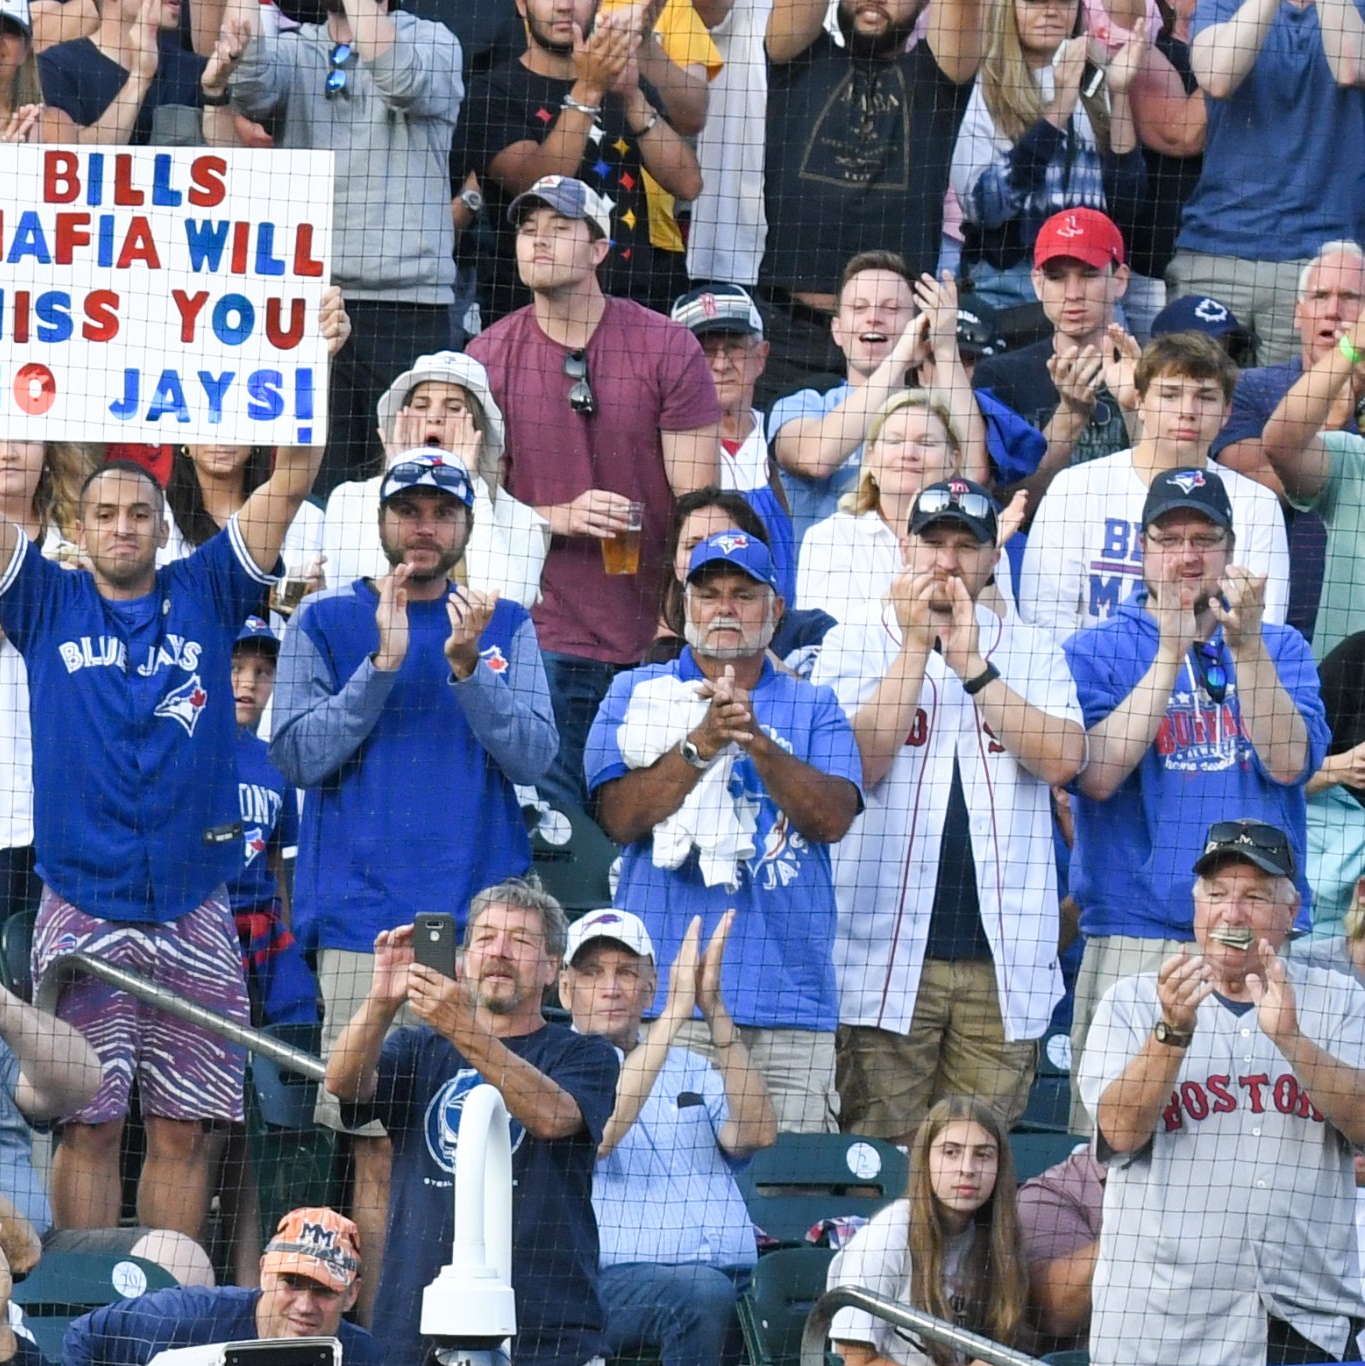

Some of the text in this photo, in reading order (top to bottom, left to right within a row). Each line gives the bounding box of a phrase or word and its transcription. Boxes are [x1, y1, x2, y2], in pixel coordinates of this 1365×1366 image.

[43, 150, 227, 207] BILLS
[184, 219, 323, 277] WILL
[171, 289, 305, 349] YOU
[109, 367, 312, 444] JAYS!
[56, 635, 124, 674] BLUE
